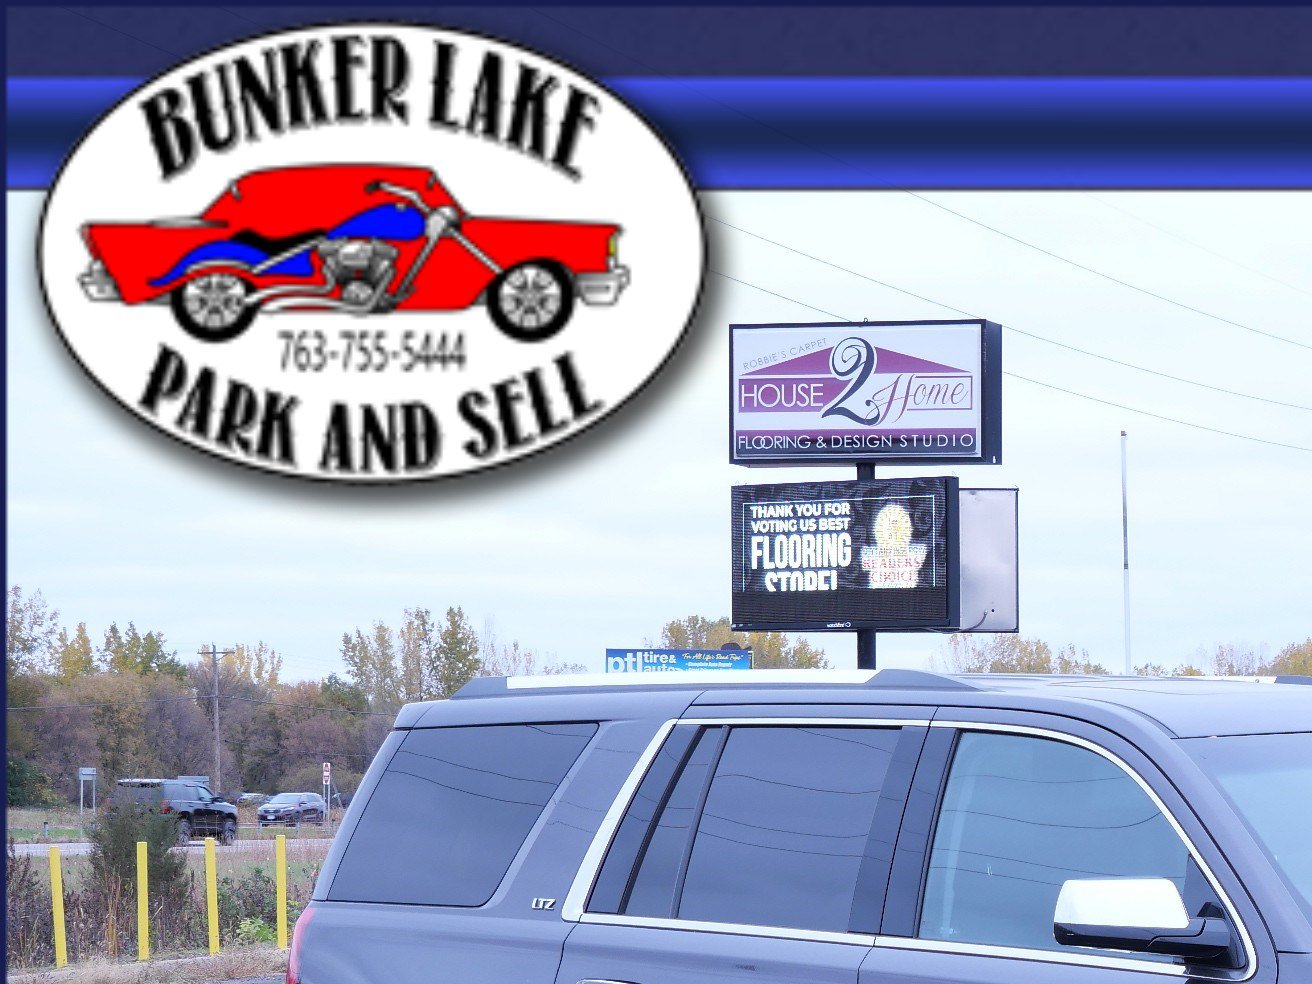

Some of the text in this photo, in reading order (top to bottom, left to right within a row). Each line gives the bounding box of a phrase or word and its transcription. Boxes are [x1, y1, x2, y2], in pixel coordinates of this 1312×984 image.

[743, 337, 828, 371] ROBBIE'S CARPET
[741, 336, 969, 426] HOUSE 2 Home
[738, 433, 974, 450] FLOORING & DESIGN STUDIO
[750, 502, 851, 519] THANK YOU FOR
[751, 517, 851, 533] VOTING US BEST
[751, 532, 852, 569] FLOORING
[531, 898, 556, 910] LTZ
